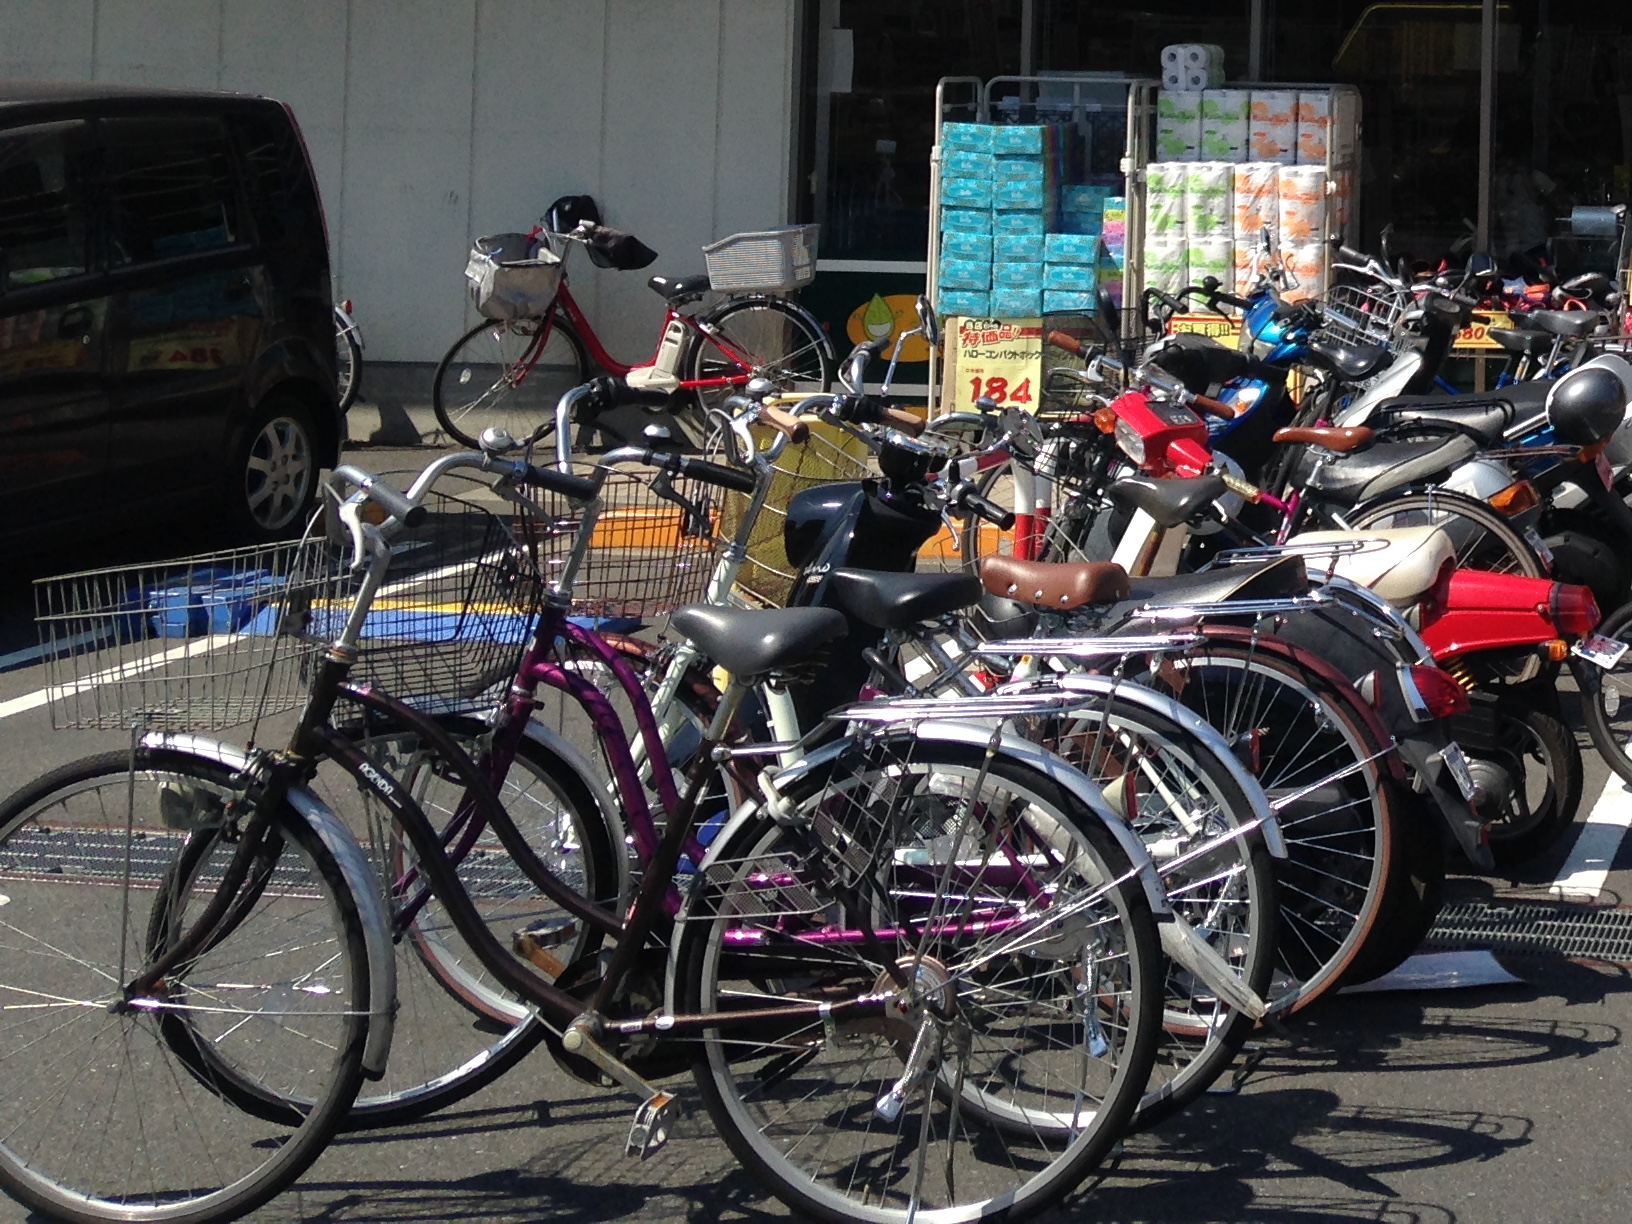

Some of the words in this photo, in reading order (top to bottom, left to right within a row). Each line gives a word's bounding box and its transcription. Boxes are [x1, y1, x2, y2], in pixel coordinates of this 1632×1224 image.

[1455, 326, 1486, 340] 80
[969, 376, 1033, 405] 184
[358, 761, 394, 796] AGENDA
